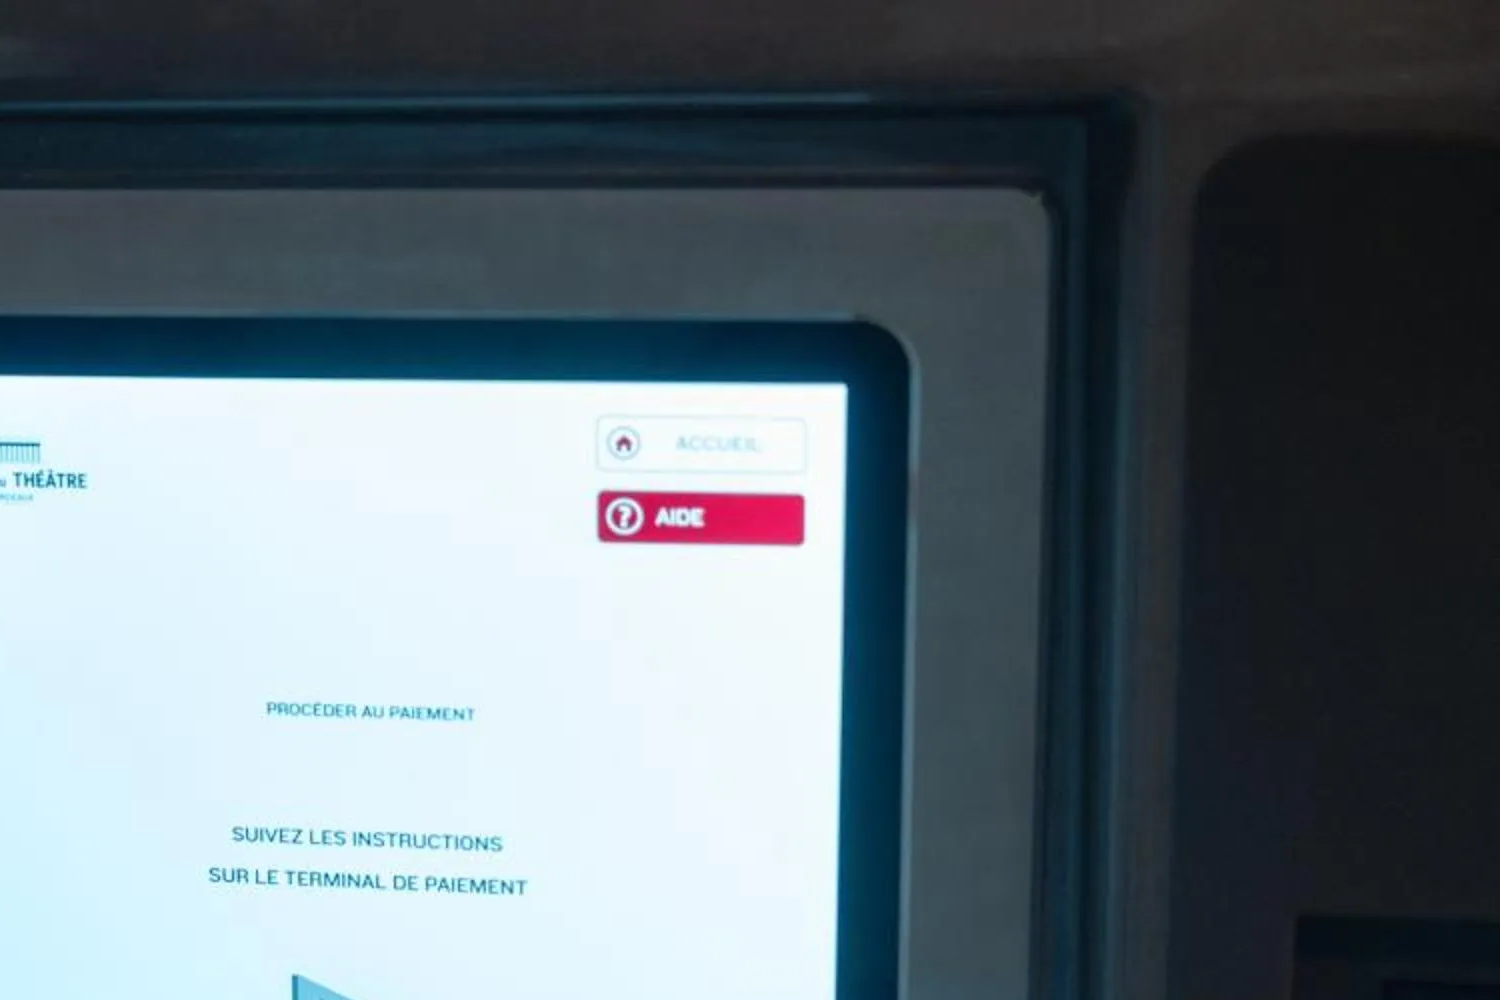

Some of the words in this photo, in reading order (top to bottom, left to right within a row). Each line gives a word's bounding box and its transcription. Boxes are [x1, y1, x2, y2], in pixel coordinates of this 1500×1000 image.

[676, 436, 760, 453] ACCUEIL
[13, 469, 88, 489] THÉÂTRE
[655, 507, 705, 528] AIDE
[266, 702, 357, 718] PROCÉDER
[361, 705, 385, 719] AU
[389, 705, 475, 721] PAIEMENT
[232, 826, 303, 845] SUIVEZ
[309, 829, 347, 846] LES
[352, 831, 504, 852] INSTRUCTIONS
[209, 867, 249, 884] SUR
[255, 869, 278, 885] LE
[285, 870, 385, 890] TERMINAL
[393, 875, 419, 891] DE
[425, 876, 527, 896] PAIEMENT
